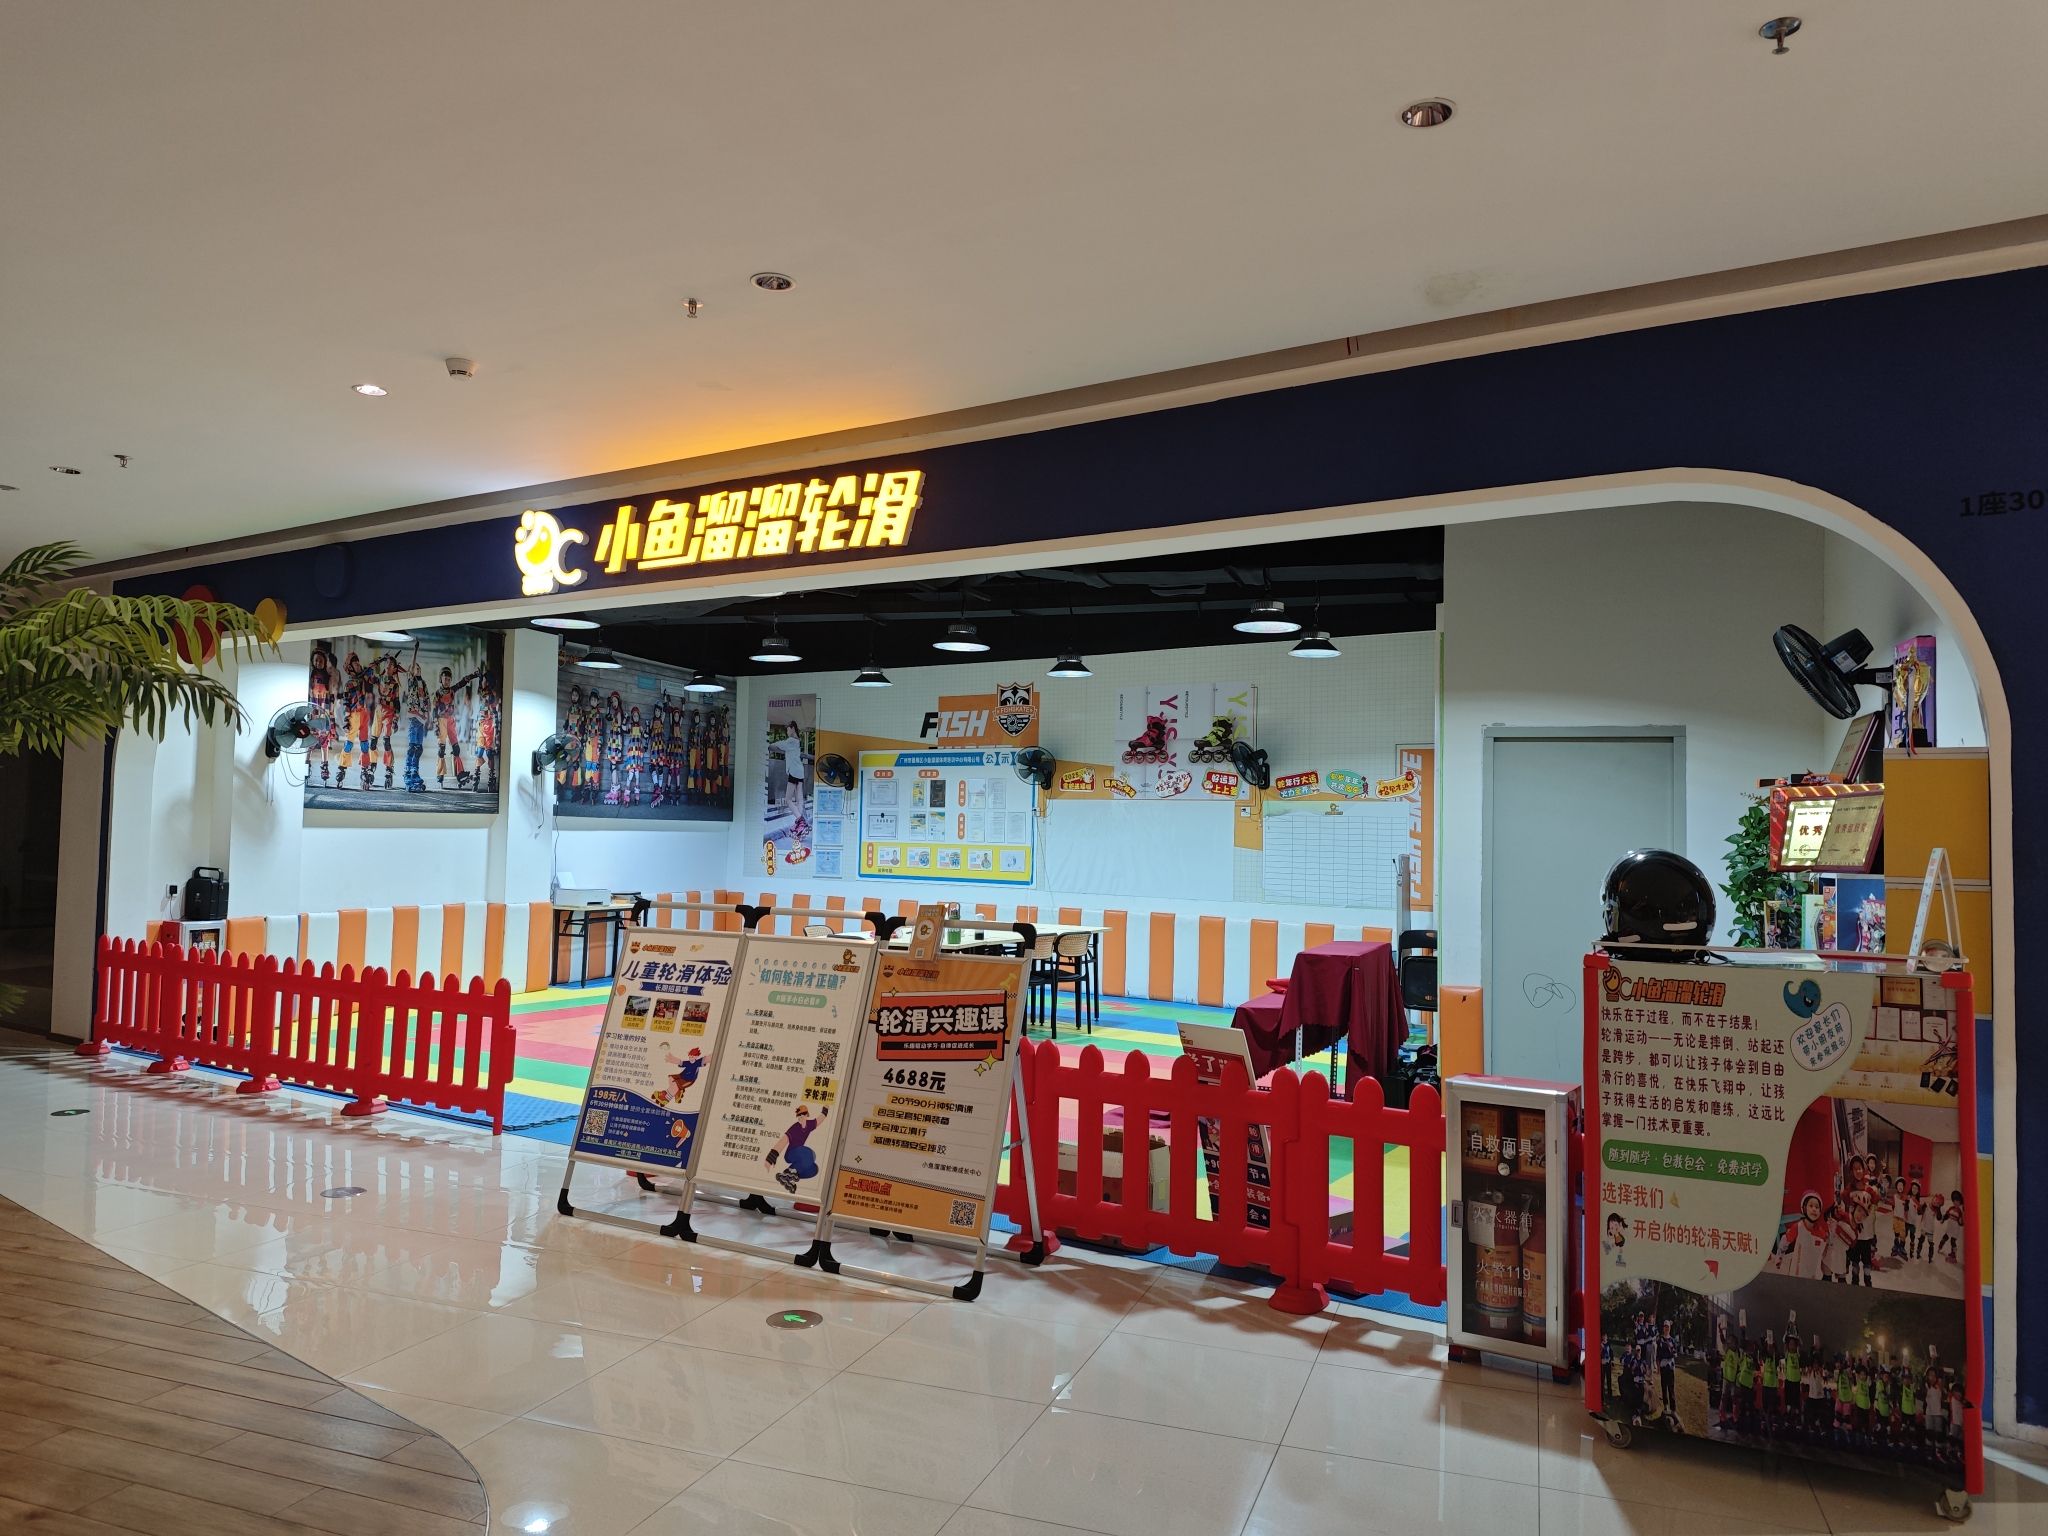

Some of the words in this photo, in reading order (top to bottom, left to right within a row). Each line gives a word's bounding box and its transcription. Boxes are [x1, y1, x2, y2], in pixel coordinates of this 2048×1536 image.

[595, 470, 927, 573] 小鱼溜溜轮滑
[1000, 706, 1030, 714] FISHSKATE
[920, 709, 989, 738] FISH
[1211, 773, 1237, 785] 好运到
[1276, 773, 1318, 789] 蛇年行大运
[1799, 824, 1824, 836] 优秀
[621, 960, 733, 986] 儿童轮滑体验
[1631, 977, 1727, 1008] 小鱼溜溜轮滑
[878, 1005, 1005, 1035] 轮滑兴趣课
[1796, 1008, 1841, 1046] 欢迎家长们
[605, 1032, 647, 1043] 学习轮滑的好处
[1601, 1049, 1786, 1077] 是跨步，都可以让孩子体会到自由
[813, 1076, 830, 1088] 咨询
[883, 1067, 946, 1091] 4688元
[1601, 1070, 1786, 1100] 滑行的喜悦，在快乐飞翔中，让孩
[592, 1089, 628, 1103] 198元/人
[891, 1095, 974, 1114] 20节90分钟轮滑课
[1601, 1091, 1786, 1122] 子获得生活的启发和磨练，这远比
[877, 1107, 951, 1126] 包含全套轮滑装备
[1601, 1112, 1711, 1138] 掌握一门技术更重要。
[862, 1120, 928, 1137] 包学会独立滑行
[873, 1135, 948, 1155] 减速转弯安全摔跤
[1471, 1132, 1535, 1157] 自救面具
[921, 1161, 982, 1177] 小鱼溜溜轮滑成长中心
[845, 1177, 892, 1196] 上课地点
[1601, 1181, 1665, 1211] 选择我们
